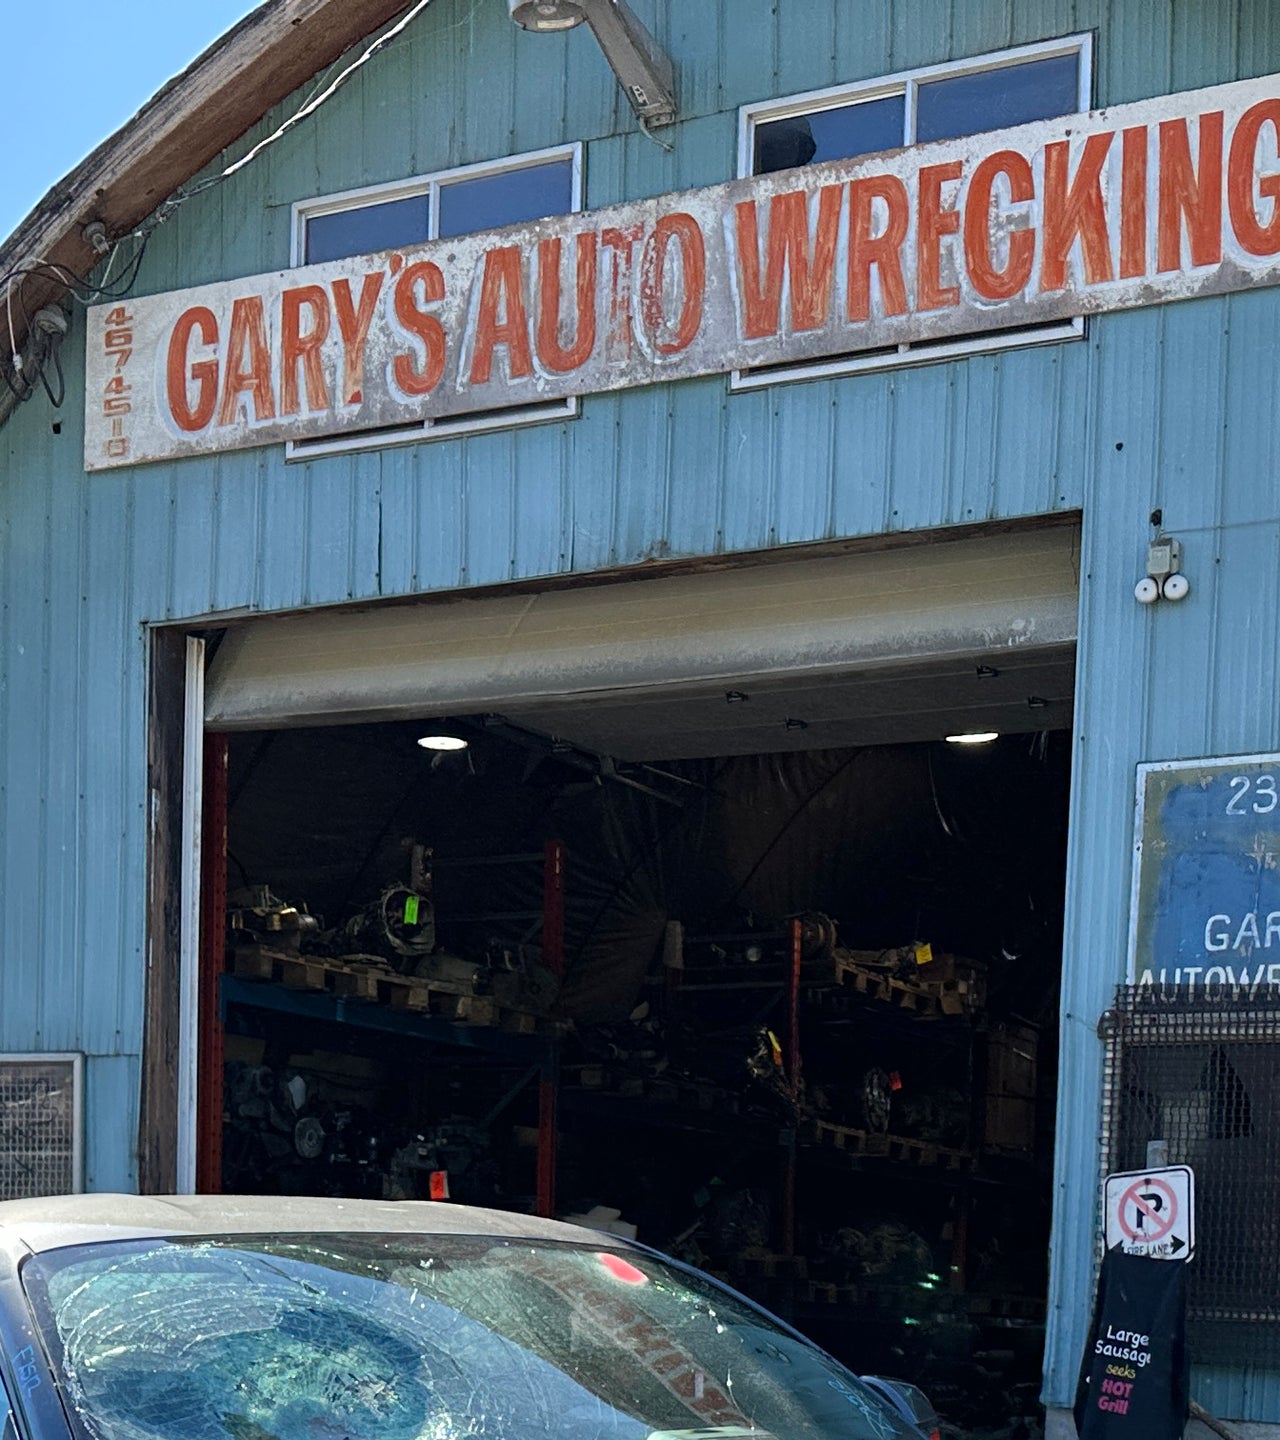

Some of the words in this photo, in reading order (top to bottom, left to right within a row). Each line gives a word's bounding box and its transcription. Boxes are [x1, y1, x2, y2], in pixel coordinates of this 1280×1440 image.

[166, 254, 446, 432] GARY'S
[468, 213, 705, 385] AUTO
[1106, 1325, 1150, 1348] Large
[1105, 1364, 1136, 1379] seeks
[1102, 1378, 1133, 1398] HOT
